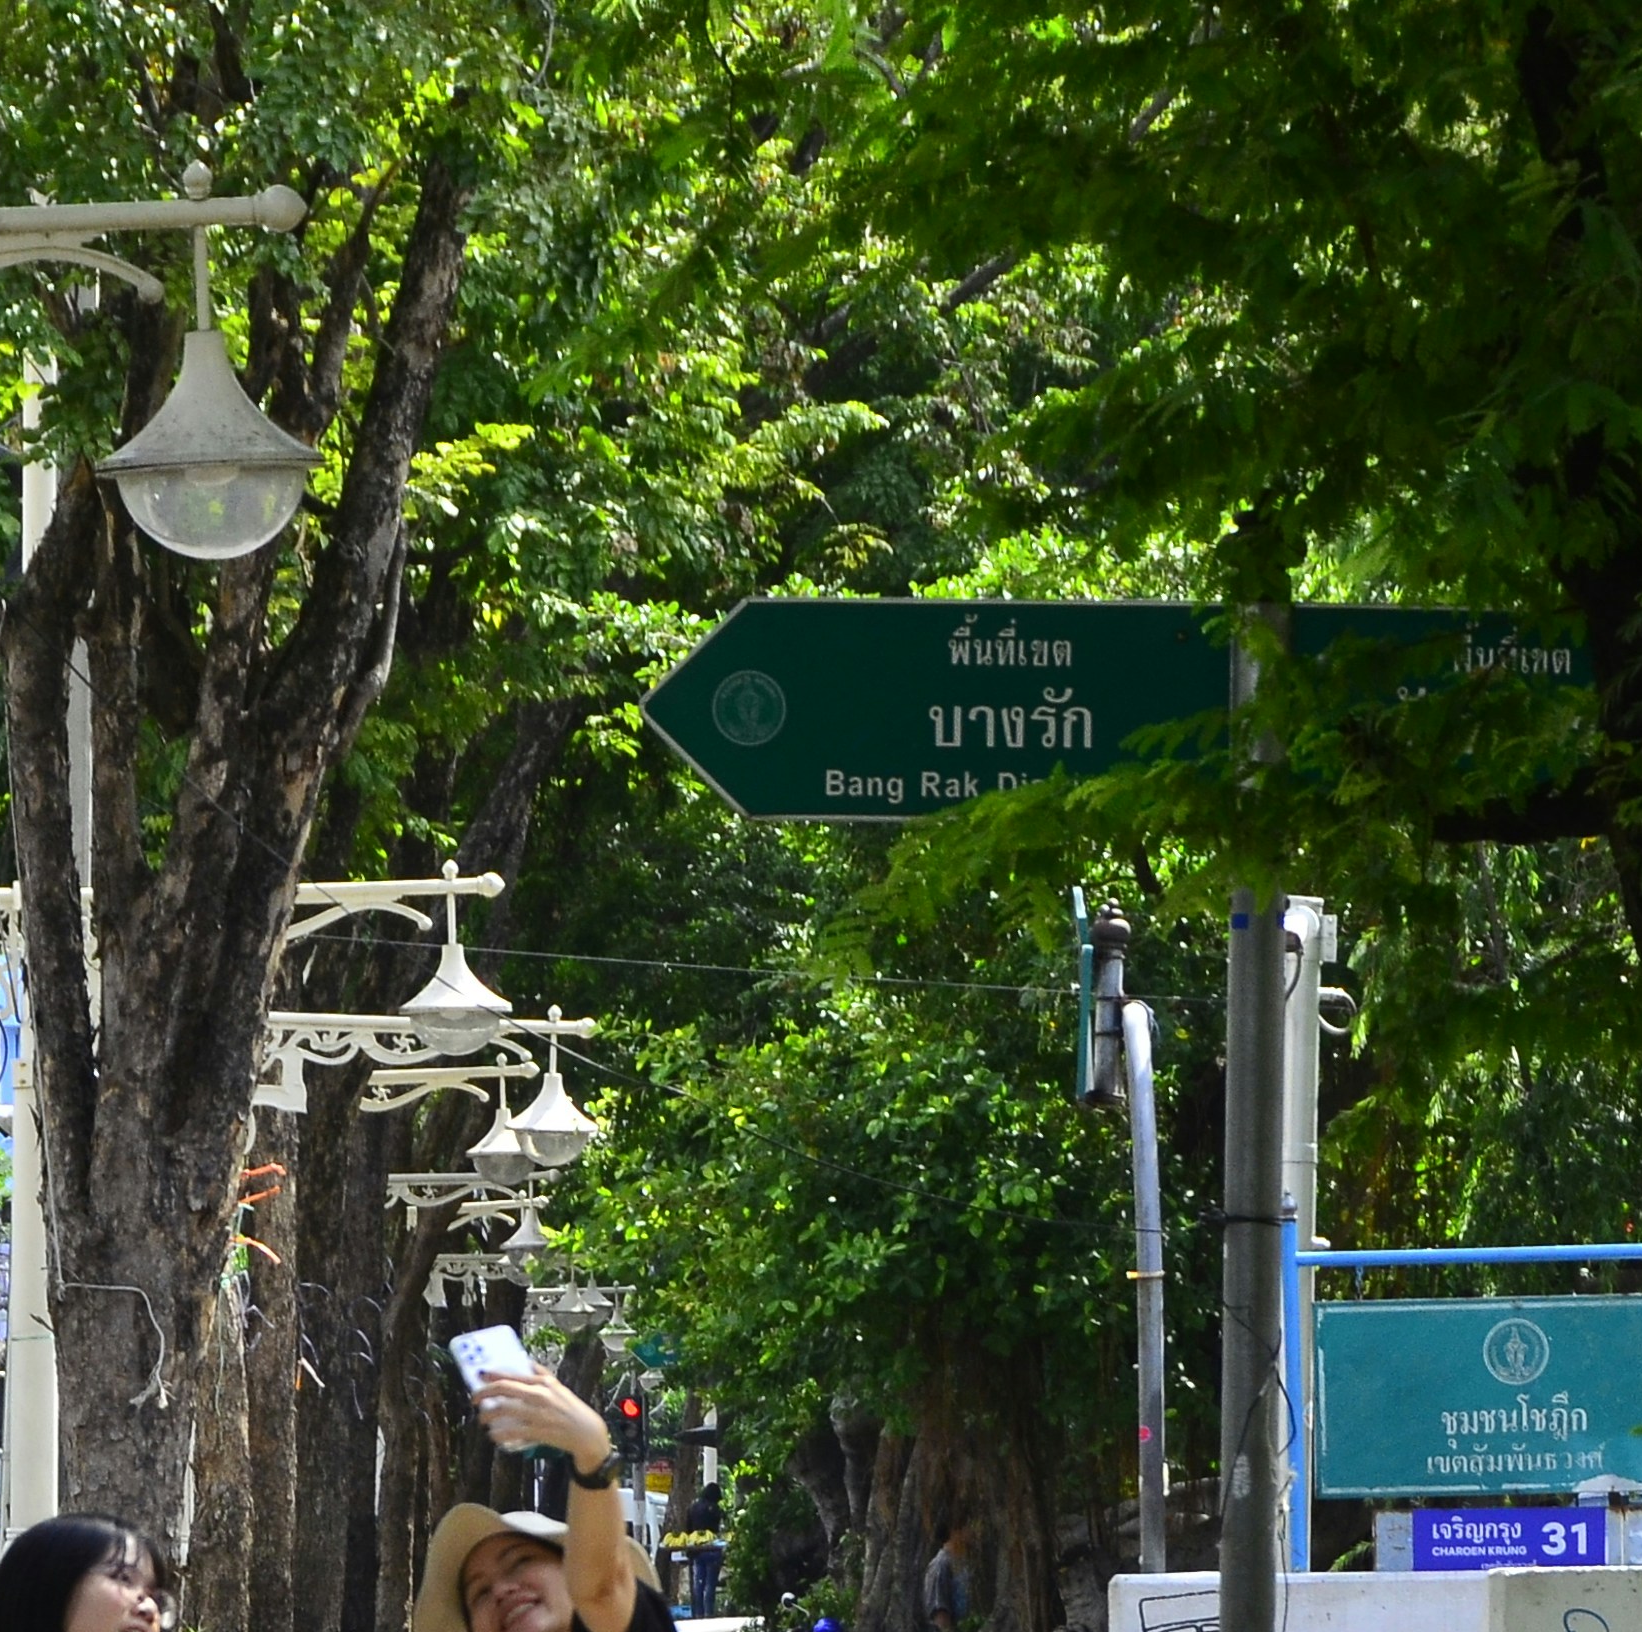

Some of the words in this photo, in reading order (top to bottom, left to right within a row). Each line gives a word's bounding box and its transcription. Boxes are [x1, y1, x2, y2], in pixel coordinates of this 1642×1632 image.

[948, 613, 1073, 667] พื้นที่เขต
[928, 686, 1093, 749] บางรัก
[825, 769, 904, 804] Bang
[920, 770, 979, 798] Rak
[1432, 1514, 1522, 1545] เจริญกรุง
[1541, 1521, 1587, 1556] 31
[1432, 1546, 1486, 1556] CHAROEN
[1488, 1545, 1527, 1555] KRUNG
